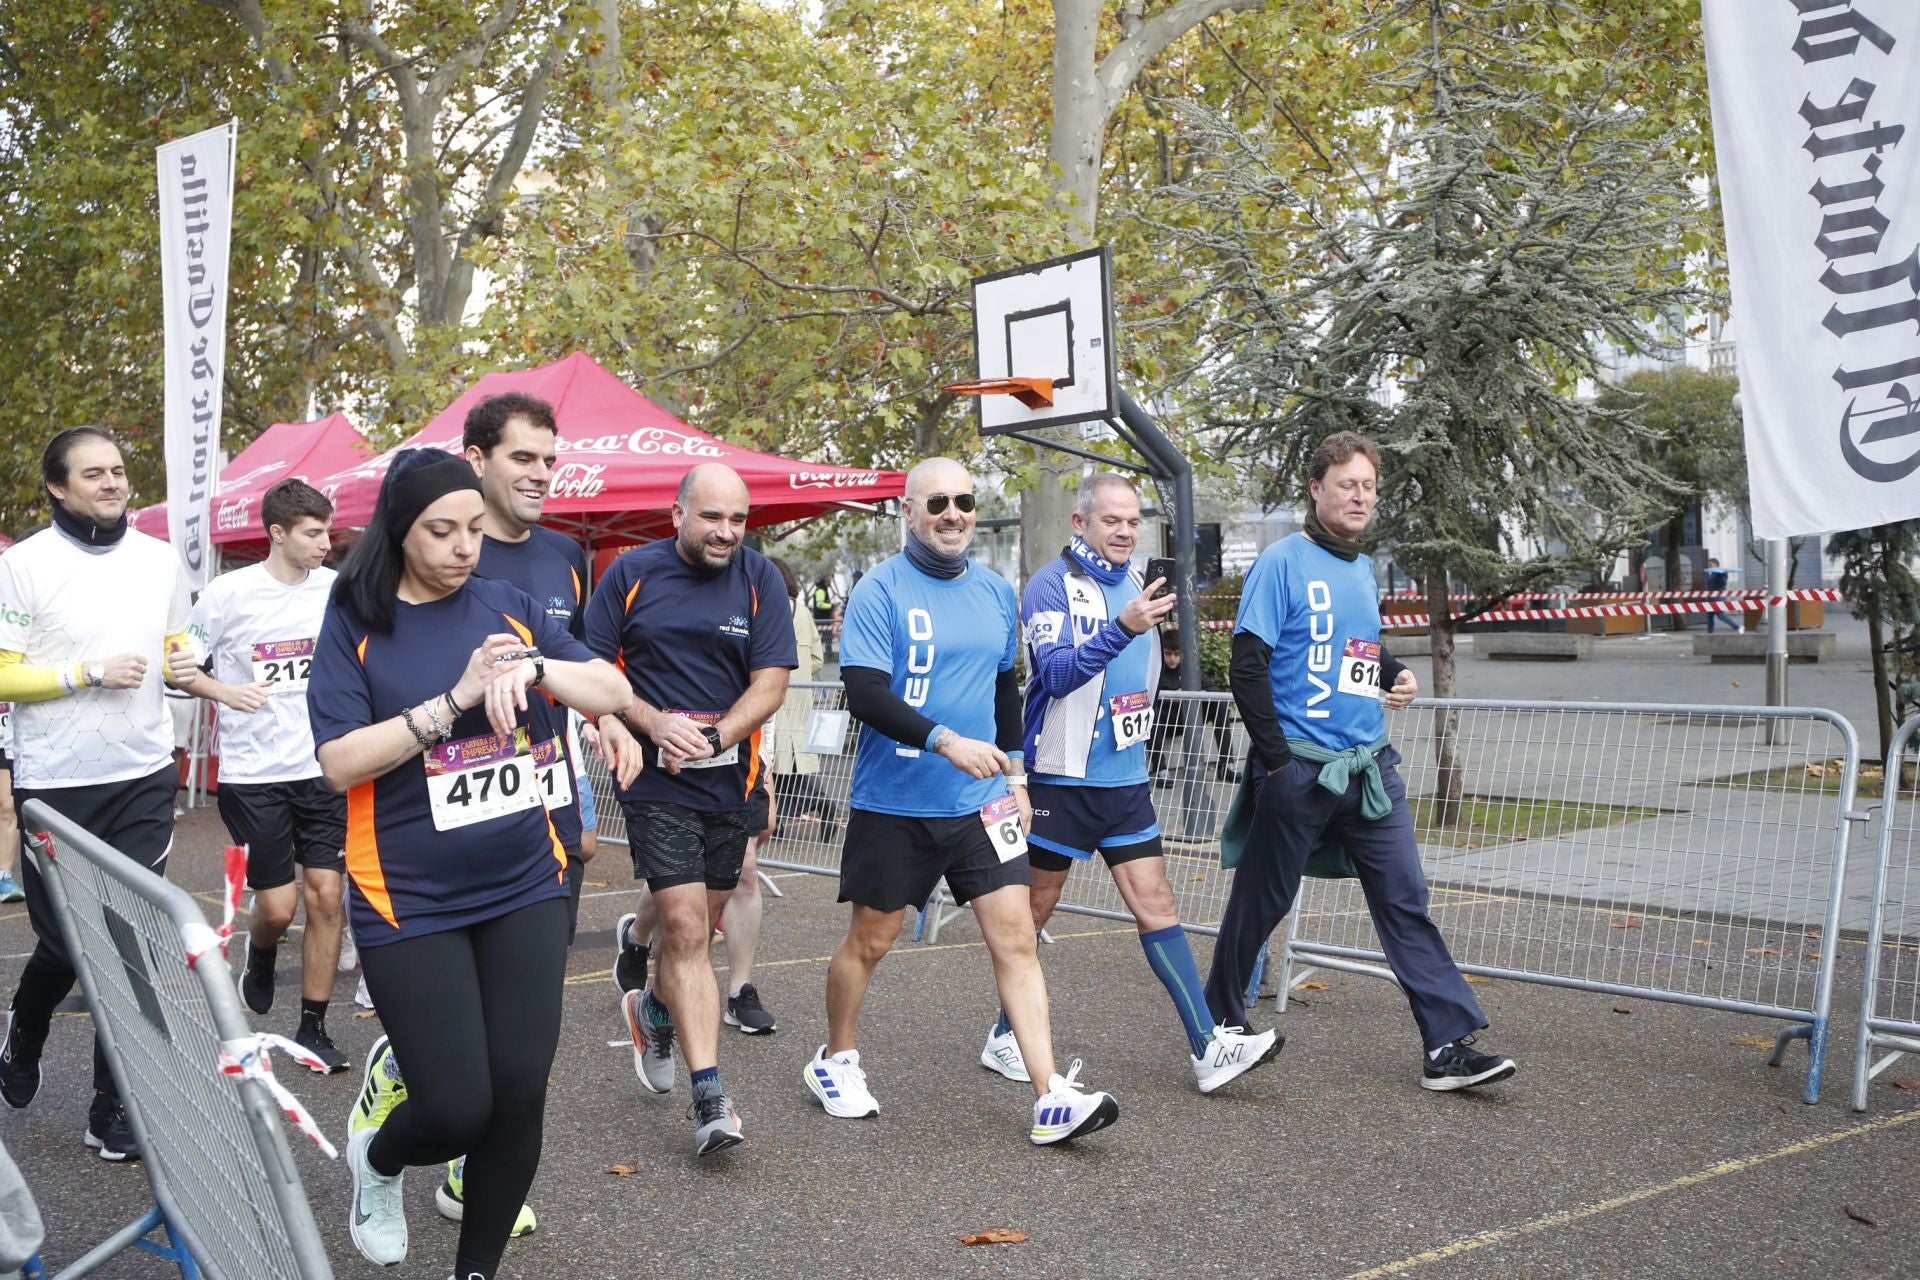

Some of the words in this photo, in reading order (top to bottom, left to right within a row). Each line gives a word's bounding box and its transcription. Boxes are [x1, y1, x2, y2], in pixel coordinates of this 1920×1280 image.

[554, 427, 731, 457] oca-Cola
[1307, 580, 1334, 718] IVECO
[263, 658, 312, 682] 212
[896, 608, 934, 758] IECO
[1122, 711, 1150, 738] 611
[460, 739, 488, 751] CARRERA
[488, 736, 497, 746] DE
[461, 744, 499, 759] EMPRESAS
[446, 763, 520, 807] 470
[541, 768, 554, 796] 1
